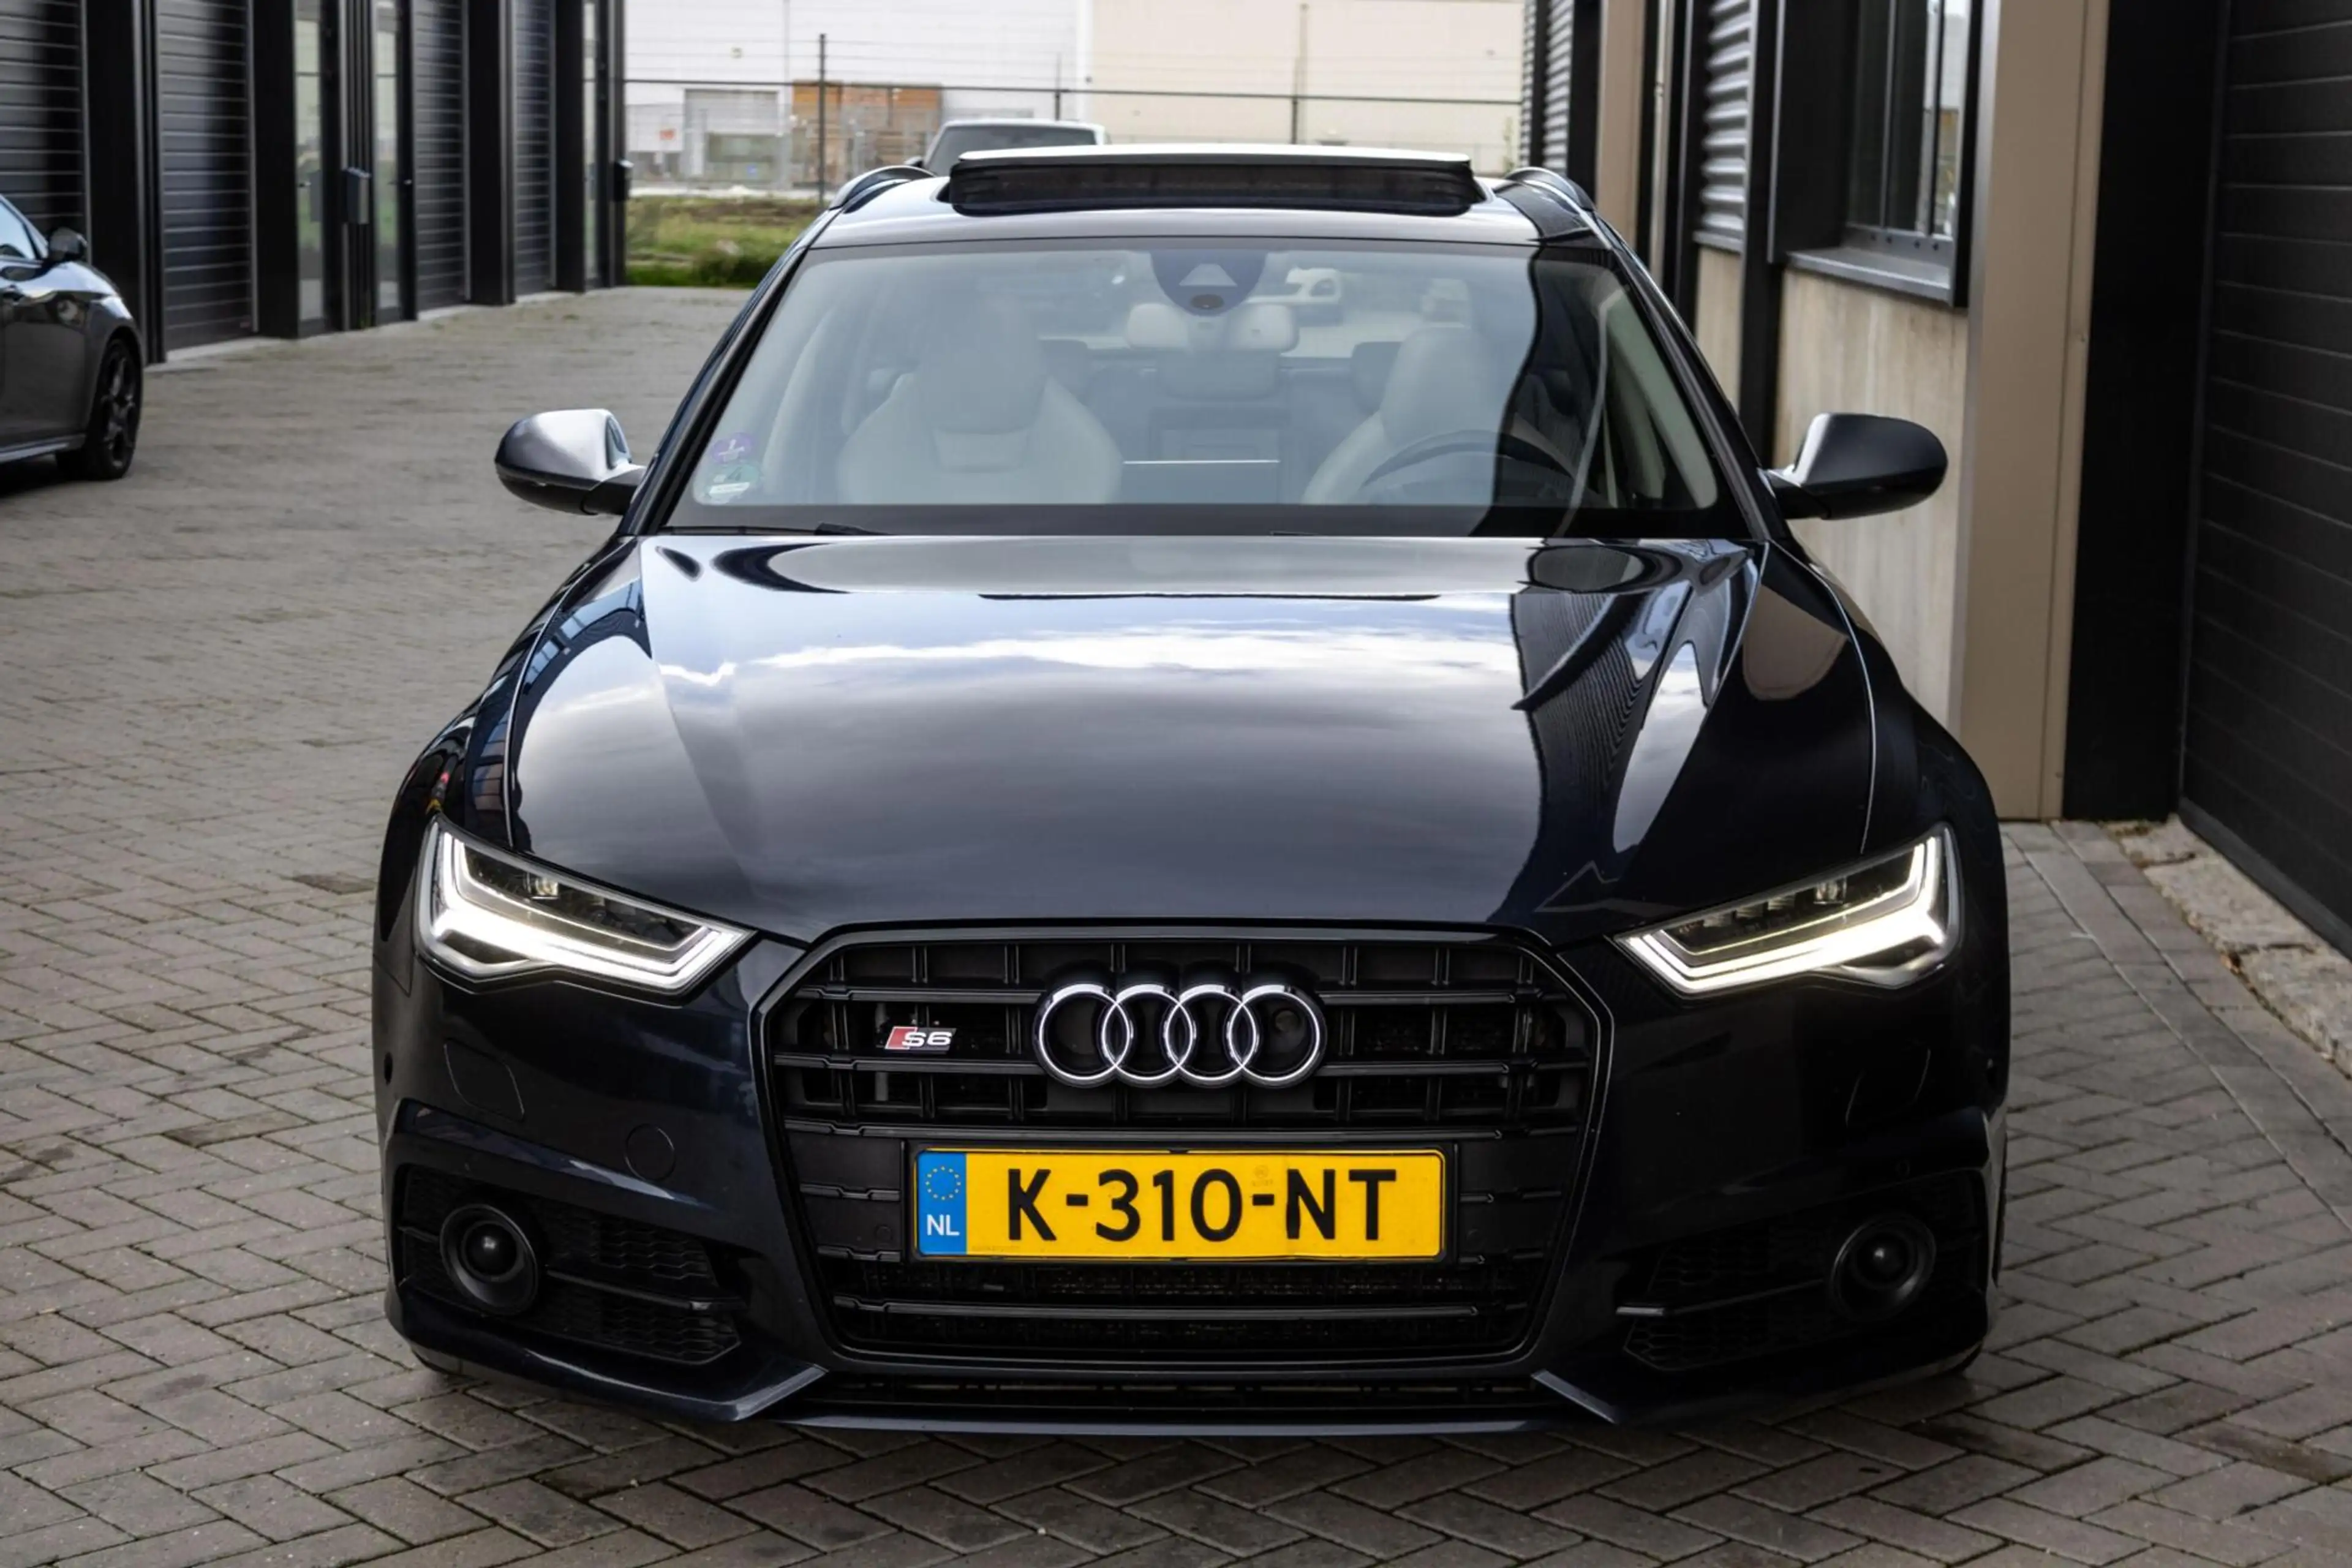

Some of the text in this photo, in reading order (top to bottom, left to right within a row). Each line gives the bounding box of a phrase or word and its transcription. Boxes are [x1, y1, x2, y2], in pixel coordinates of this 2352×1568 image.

[901, 1031, 953, 1047] S6
[1008, 1168, 1397, 1242] K-310-NT
[926, 1213, 960, 1236] NL
